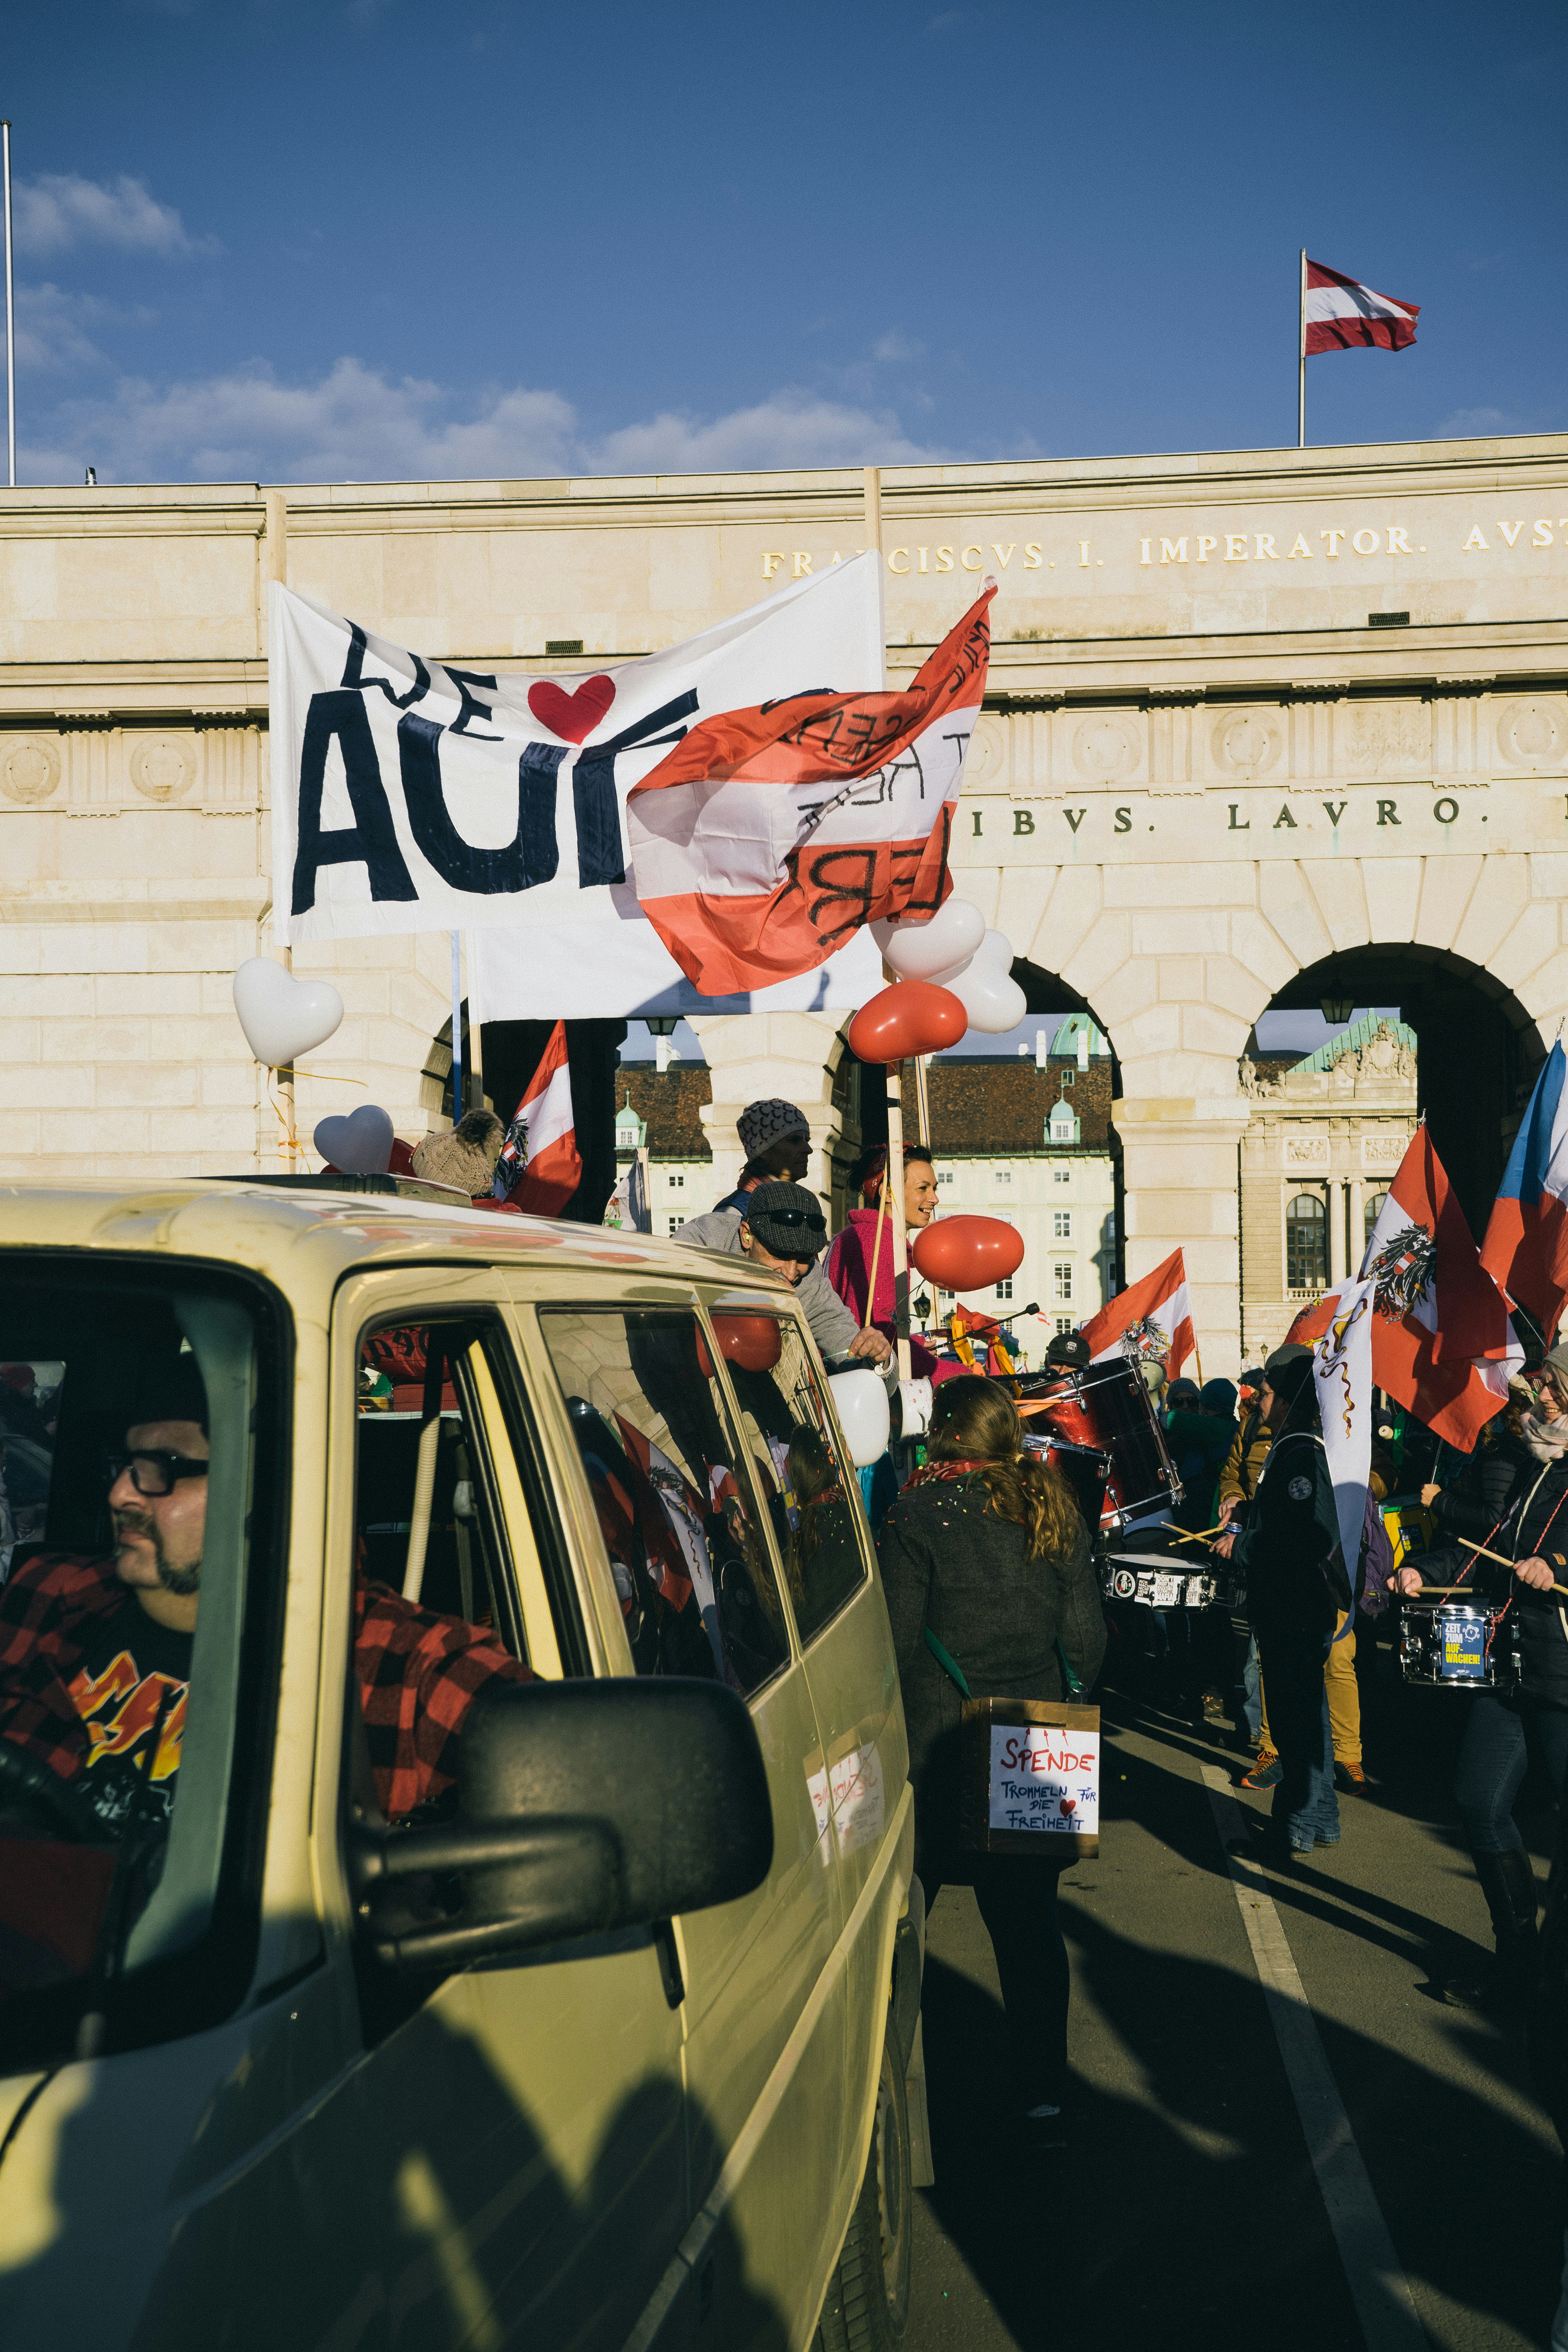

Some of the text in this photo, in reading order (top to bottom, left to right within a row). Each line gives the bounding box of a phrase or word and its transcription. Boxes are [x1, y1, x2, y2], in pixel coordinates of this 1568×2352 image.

[762, 543, 1055, 579] FRCISCVS.
[1078, 541, 1103, 567] I.
[1140, 526, 1427, 565] IMPERATOR.
[340, 617, 504, 741] WE
[972, 797, 1489, 837] IBVS. LAVRO.
[1445, 1623, 1461, 1633] ZEIT
[1445, 1633, 1463, 1644] ZUM
[1446, 1643, 1463, 1653] AUF-
[1446, 1653, 1480, 1664] WACHEN!
[1000, 1738, 1095, 1772] SPENDE
[1001, 1780, 1067, 1799] TROMMELN
